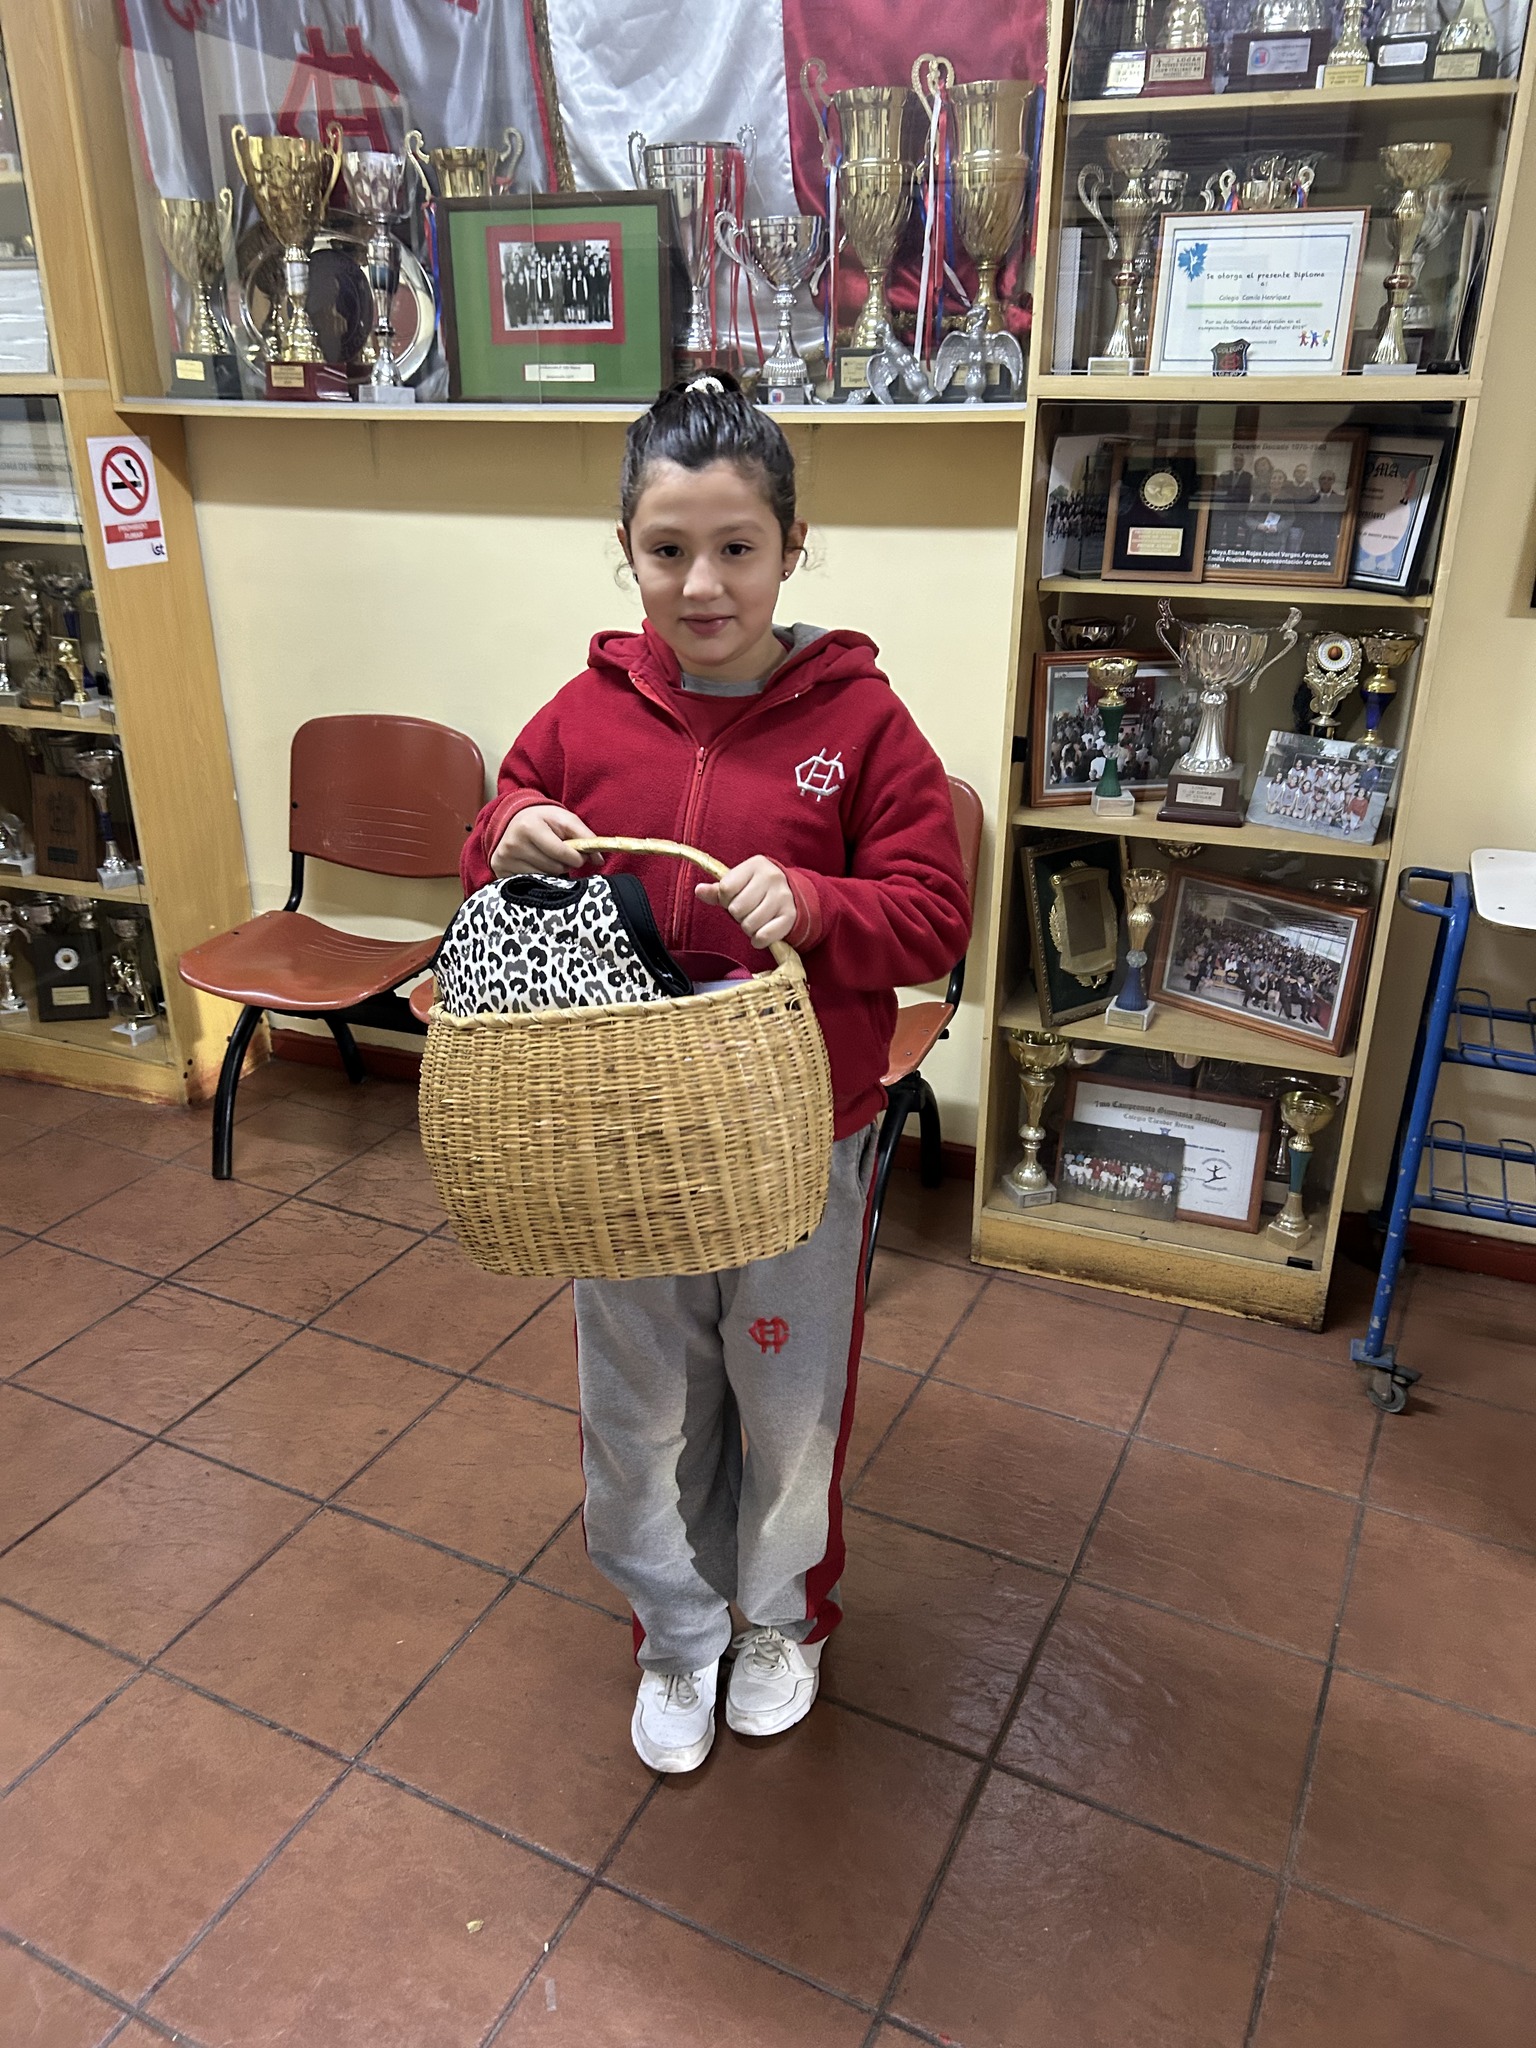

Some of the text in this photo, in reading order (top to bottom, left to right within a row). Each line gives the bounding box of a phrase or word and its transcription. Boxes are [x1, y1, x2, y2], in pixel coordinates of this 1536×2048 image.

[1217, 273, 1243, 281] otorga
[1257, 272, 1291, 282] presente
[1293, 271, 1325, 282] Diploma
[1218, 294, 1240, 302] Colegio
[1312, 559, 1332, 567] Carlos
[1123, 1113, 1147, 1122] Colegio
